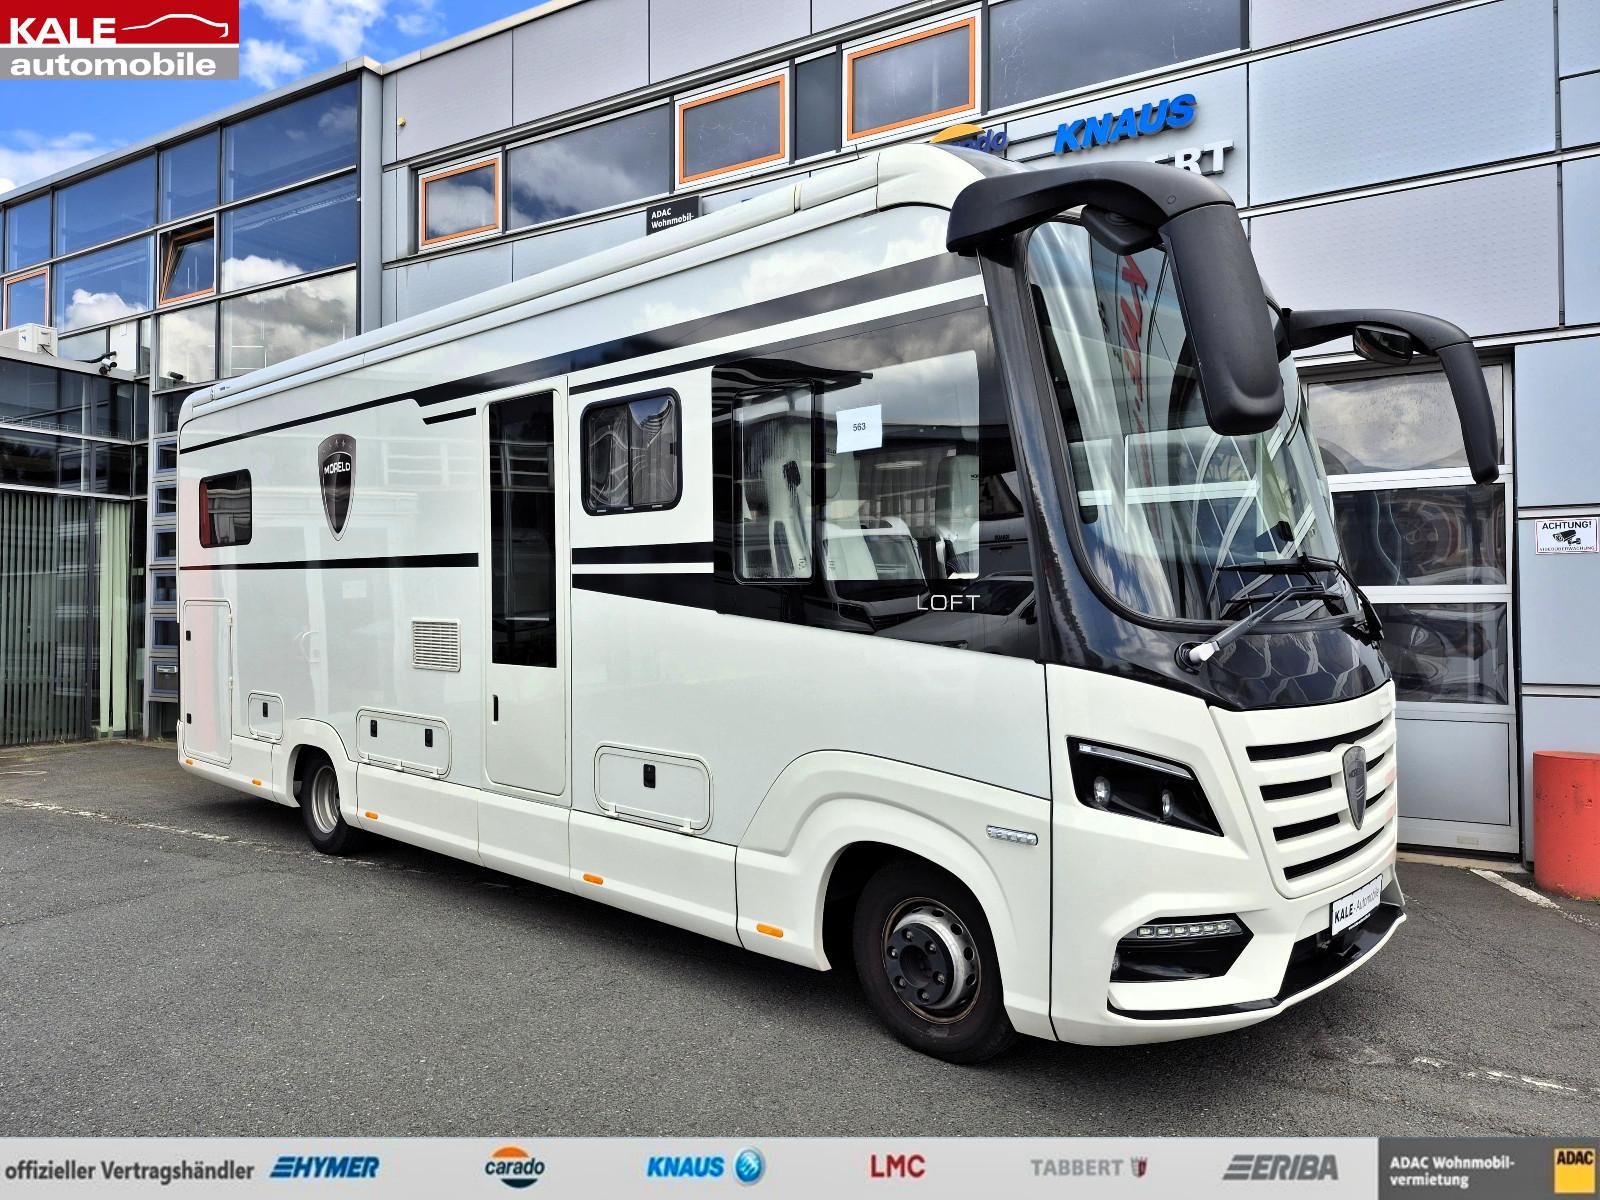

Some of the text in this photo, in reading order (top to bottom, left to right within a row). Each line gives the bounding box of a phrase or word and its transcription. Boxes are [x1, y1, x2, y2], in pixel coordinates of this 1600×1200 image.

[1054, 94, 1197, 154] KNAUS
[651, 207, 672, 219] ADAC
[651, 212, 694, 229] Wohnmobil-
[852, 422, 866, 432] 563
[1542, 520, 1592, 530] ACHTUNG!
[917, 594, 980, 611] LOFT
